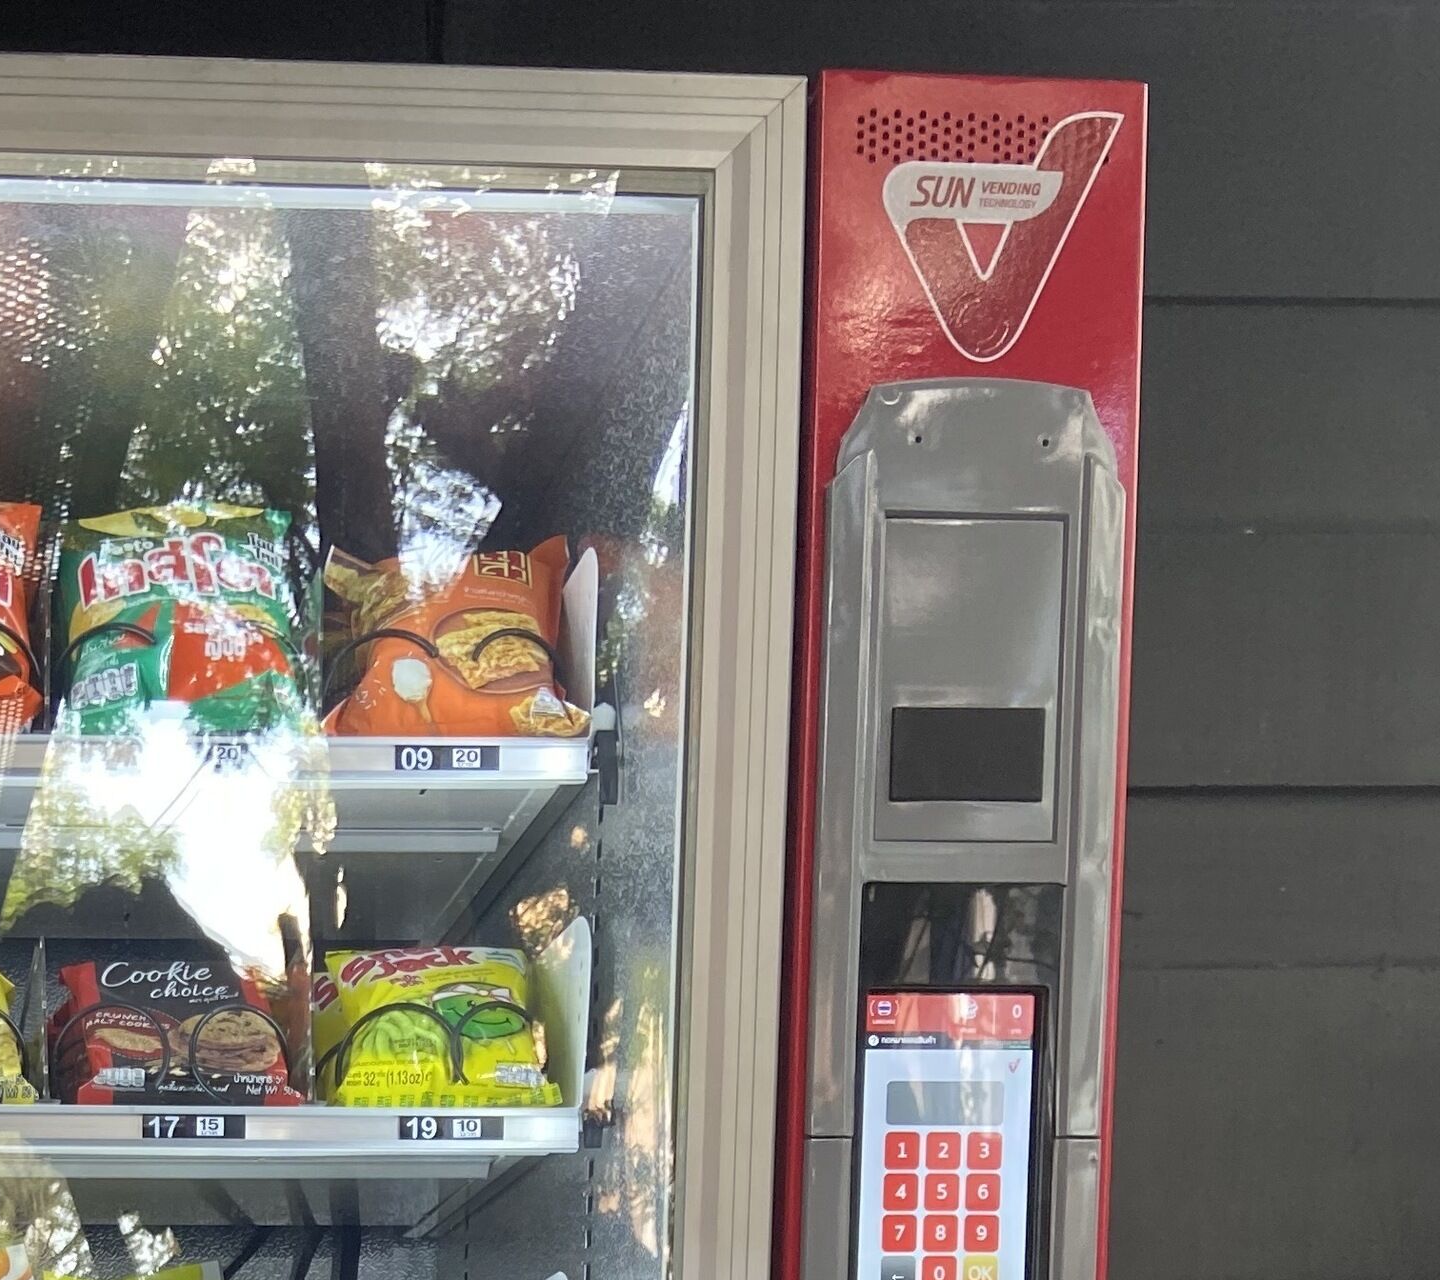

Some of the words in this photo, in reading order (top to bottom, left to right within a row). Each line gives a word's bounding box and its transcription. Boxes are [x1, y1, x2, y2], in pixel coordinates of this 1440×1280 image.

[910, 175, 975, 208] SUN
[981, 181, 1041, 197] VENDING
[401, 748, 433, 770] 09
[456, 751, 478, 763] 20
[101, 961, 213, 988] Cookie
[150, 981, 228, 999] choice
[1012, 1004, 1022, 1019] 0
[406, 1117, 438, 1140] 19
[458, 1121, 478, 1132] 10
[897, 1142, 908, 1159] 1
[938, 1143, 949, 1159] 2
[978, 1143, 990, 1159] 3
[894, 1184, 907, 1200] 4
[936, 1184, 948, 1200] 5
[977, 1184, 989, 1201] 6
[894, 1225, 906, 1241] 7
[934, 1225, 947, 1241] 8
[975, 1225, 988, 1241] 9
